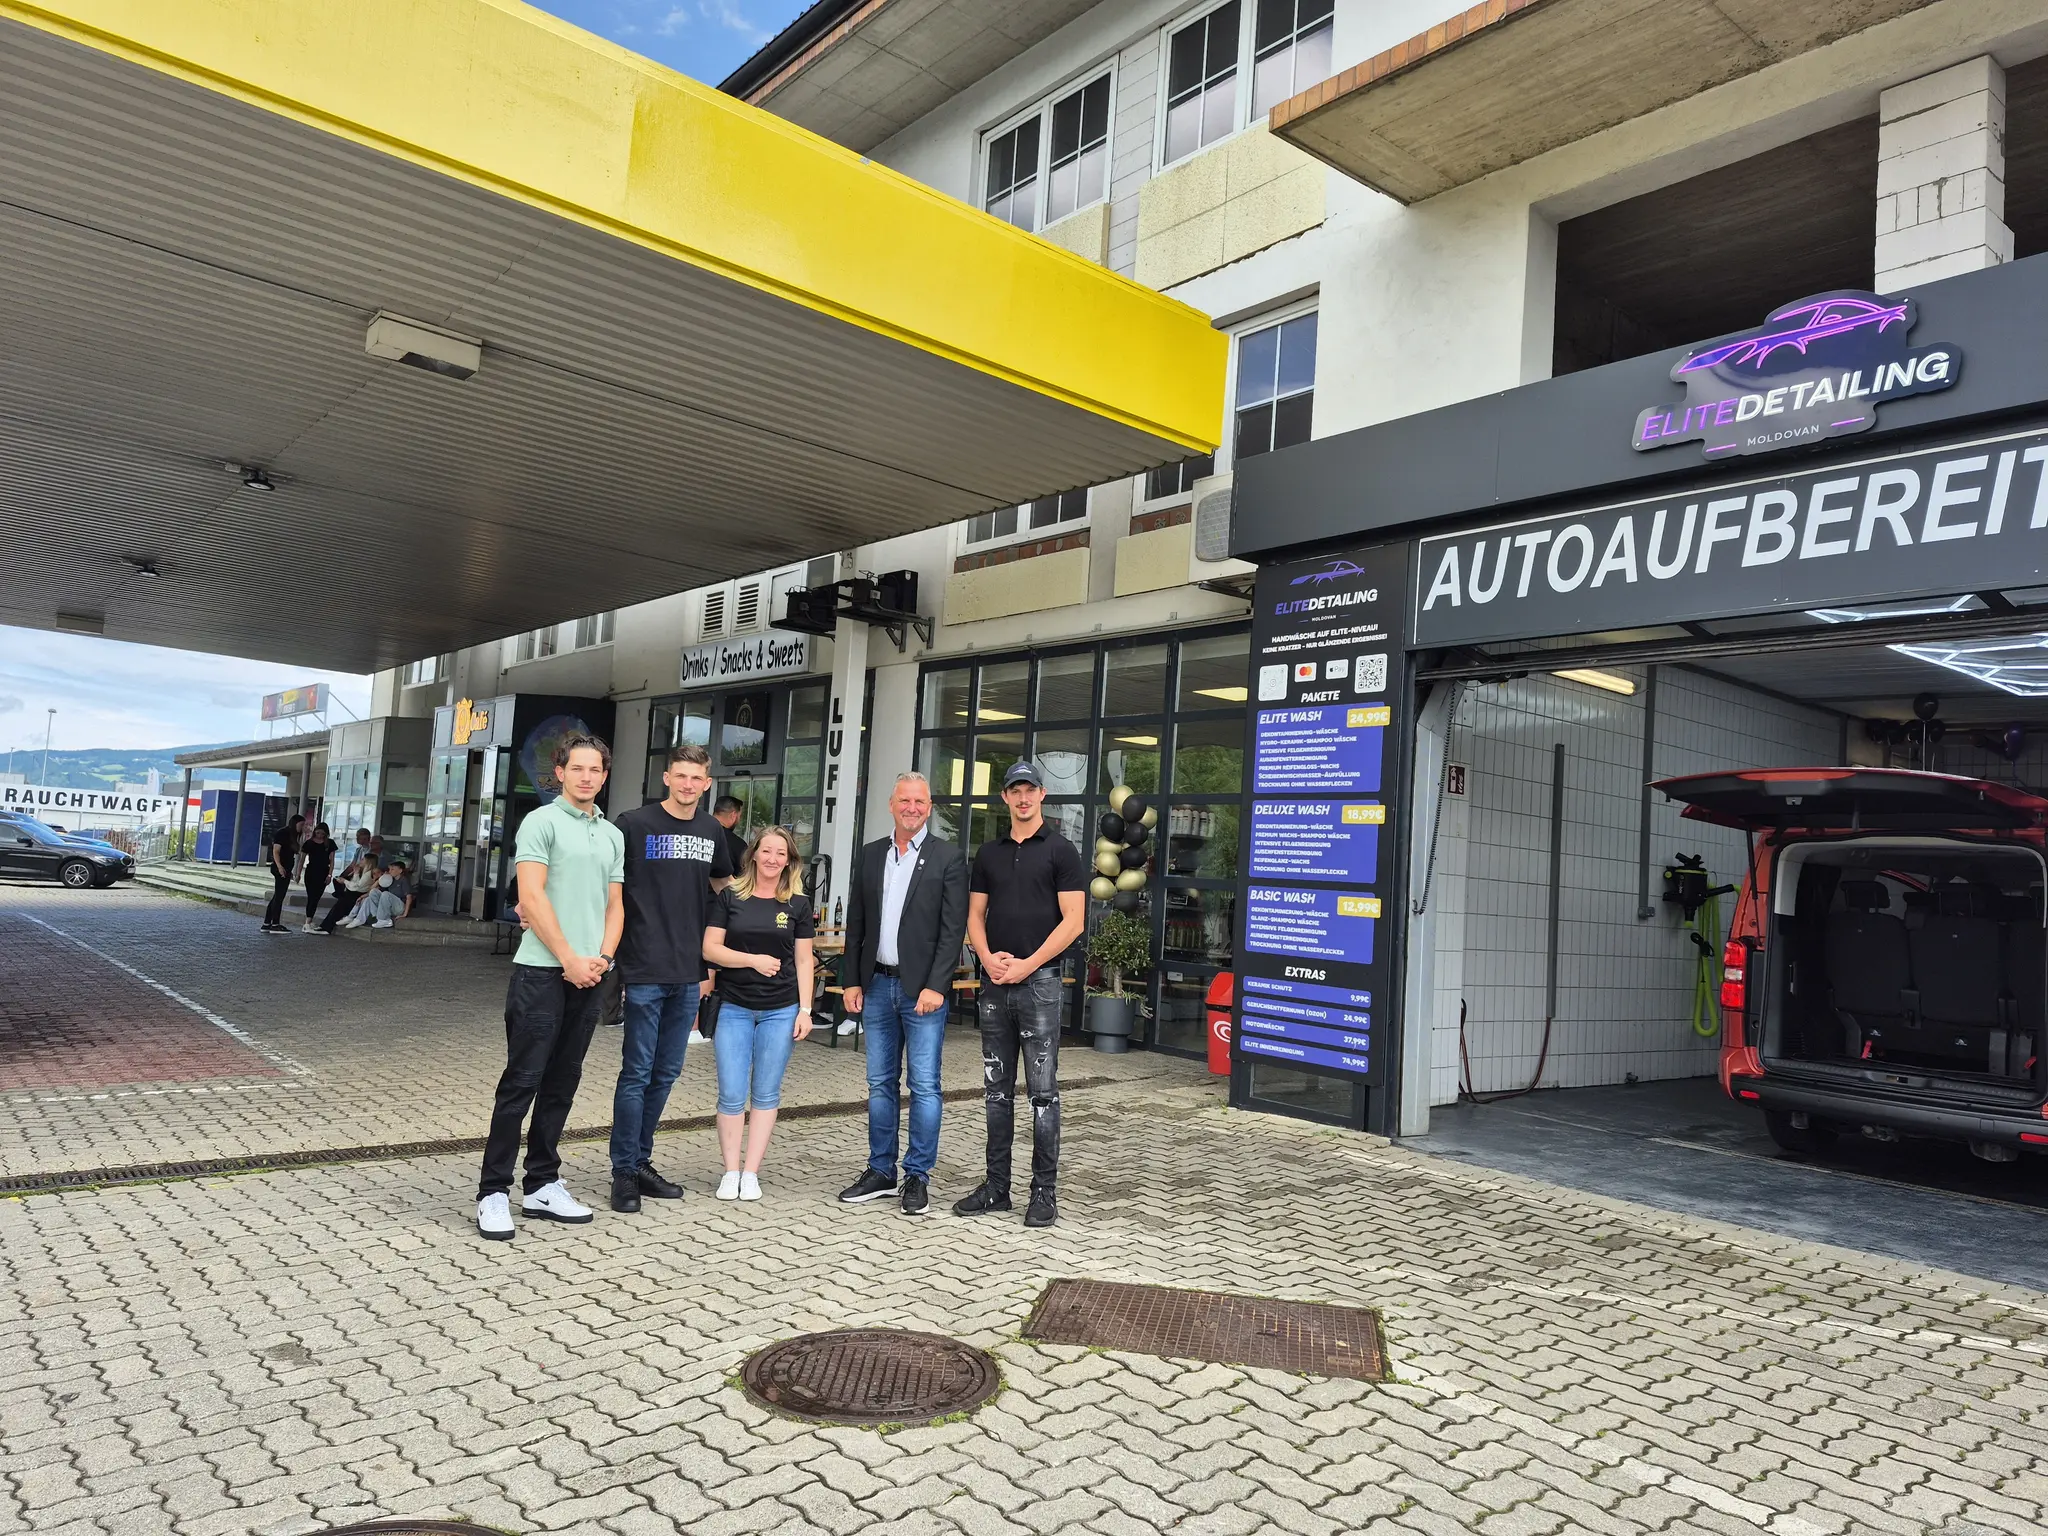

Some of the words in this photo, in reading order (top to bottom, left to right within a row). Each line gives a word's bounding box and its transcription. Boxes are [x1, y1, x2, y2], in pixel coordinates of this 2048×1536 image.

[1640, 352, 1950, 442] ELITEDETAILING
[1747, 424, 1820, 447] MOLDOVAN
[1275, 589, 1378, 615] ELITEDETAILING
[1317, 630, 1329, 638] AUF
[1278, 644, 1301, 652] KRATZER
[682, 649, 709, 681] Drinks
[711, 646, 718, 676] /
[720, 642, 753, 675] Snacks
[756, 639, 763, 670] &
[767, 637, 804, 669] Sweets
[1301, 691, 1340, 703] PAKETE
[470, 711, 489, 731] Café
[1260, 713, 1288, 724] ELITE
[1290, 711, 1322, 722] WASH
[1350, 712, 1389, 724] 24,99€
[825, 698, 843, 823] LUFT
[1255, 805, 1295, 815] DELUXE
[1298, 805, 1330, 815] WASH
[1347, 809, 1383, 820] 18,99€
[1250, 890, 1281, 901] BASIC
[1283, 891, 1316, 904] WASH
[1343, 901, 1379, 913] 12,99€
[1285, 966, 1326, 980] EXTRAS
[1247, 981, 1270, 989] KERAMIK
[1271, 984, 1292, 992] SCHUTZ
[1344, 1014, 1367, 1024] 24,99€
